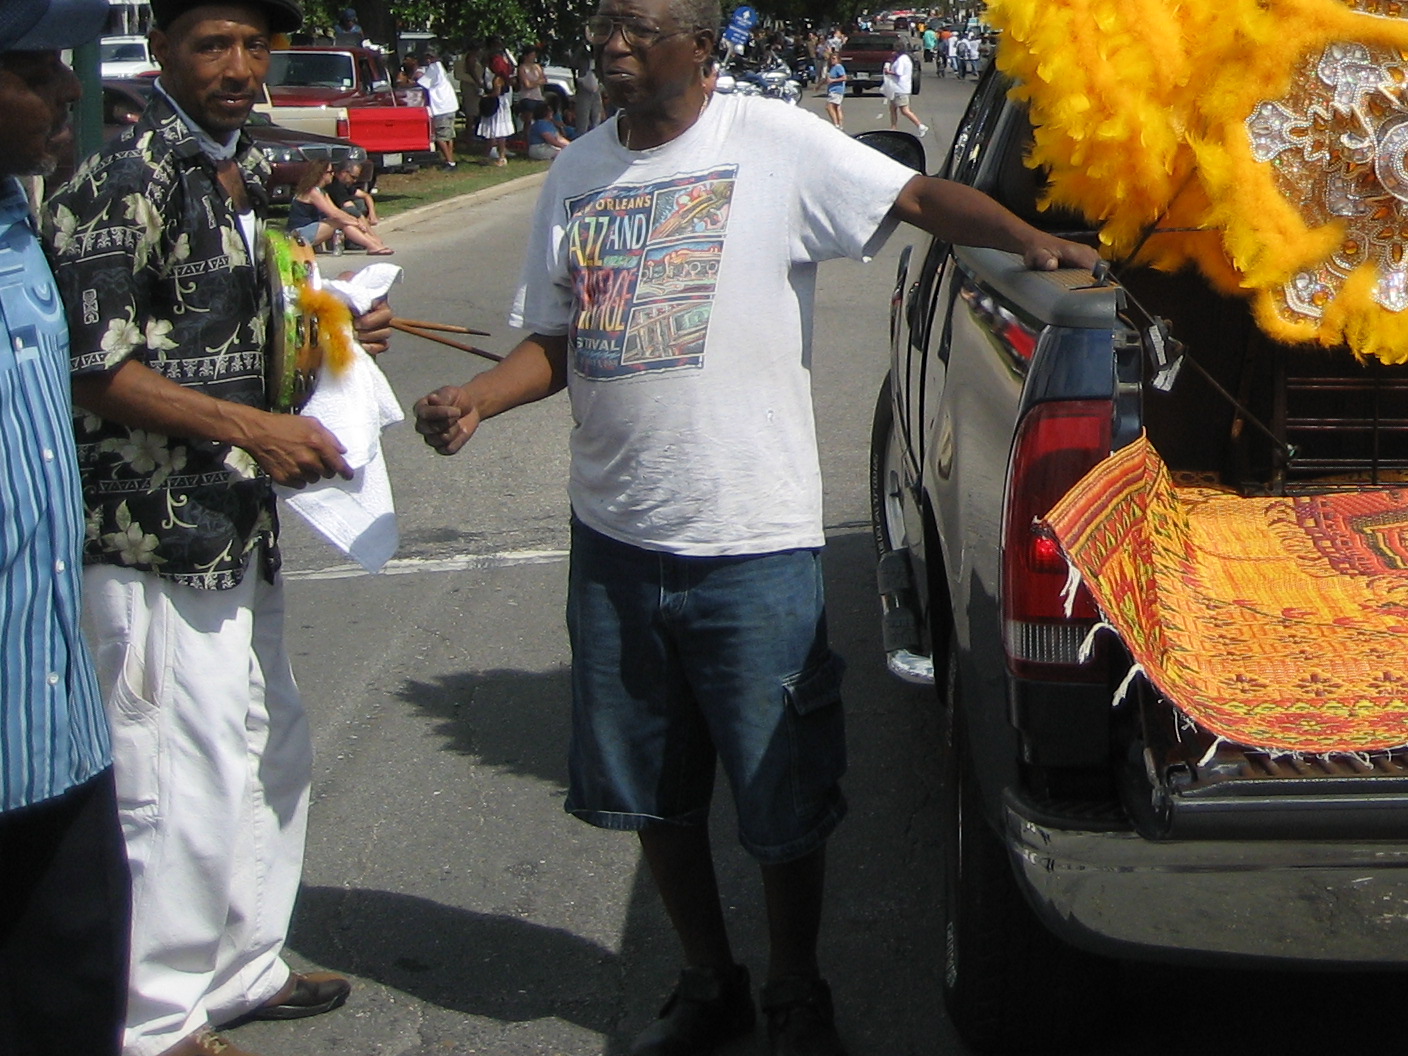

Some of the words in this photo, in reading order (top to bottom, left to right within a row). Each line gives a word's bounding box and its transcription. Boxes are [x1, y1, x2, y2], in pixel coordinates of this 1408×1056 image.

[596, 195, 652, 212] ORLEANS
[567, 216, 612, 267] AZZ
[606, 213, 647, 250] AND
